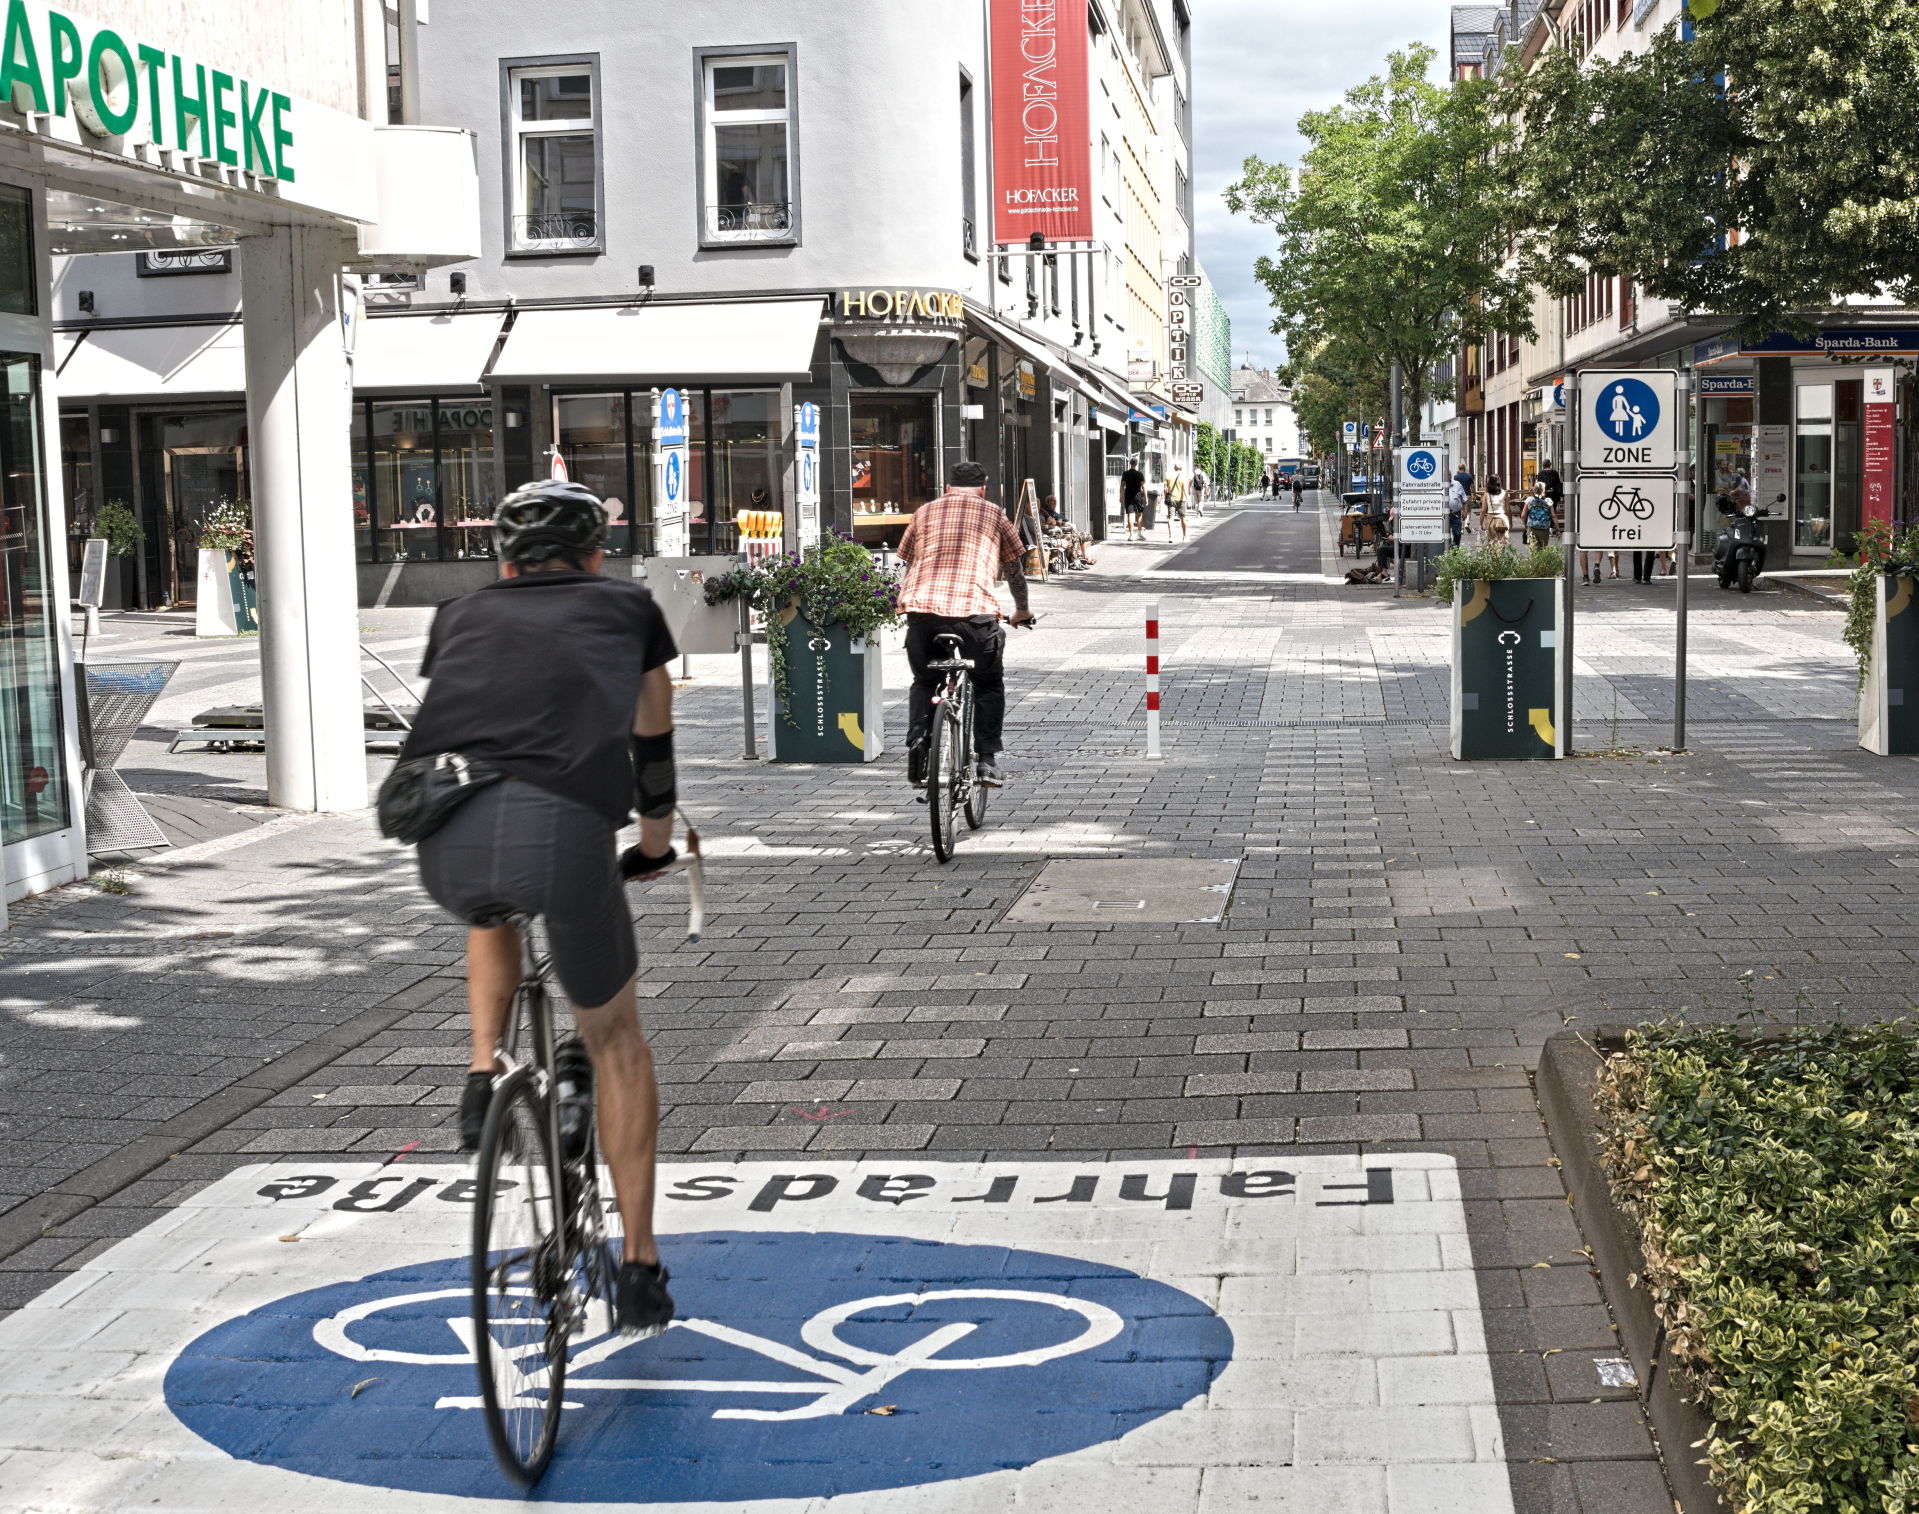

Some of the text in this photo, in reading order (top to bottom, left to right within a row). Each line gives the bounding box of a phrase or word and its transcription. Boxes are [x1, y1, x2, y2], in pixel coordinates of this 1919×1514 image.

[0, 0, 295, 183] APOTHEKE
[1005, 187, 1079, 204] HOFACKER
[1170, 292, 1185, 380] OPTIK
[1815, 337, 1898, 350] Sparda-Bank
[1603, 447, 1652, 463] ZONE
[1611, 525, 1642, 540] frei
[1506, 649, 1514, 733] SCHLOSSSTRASSE
